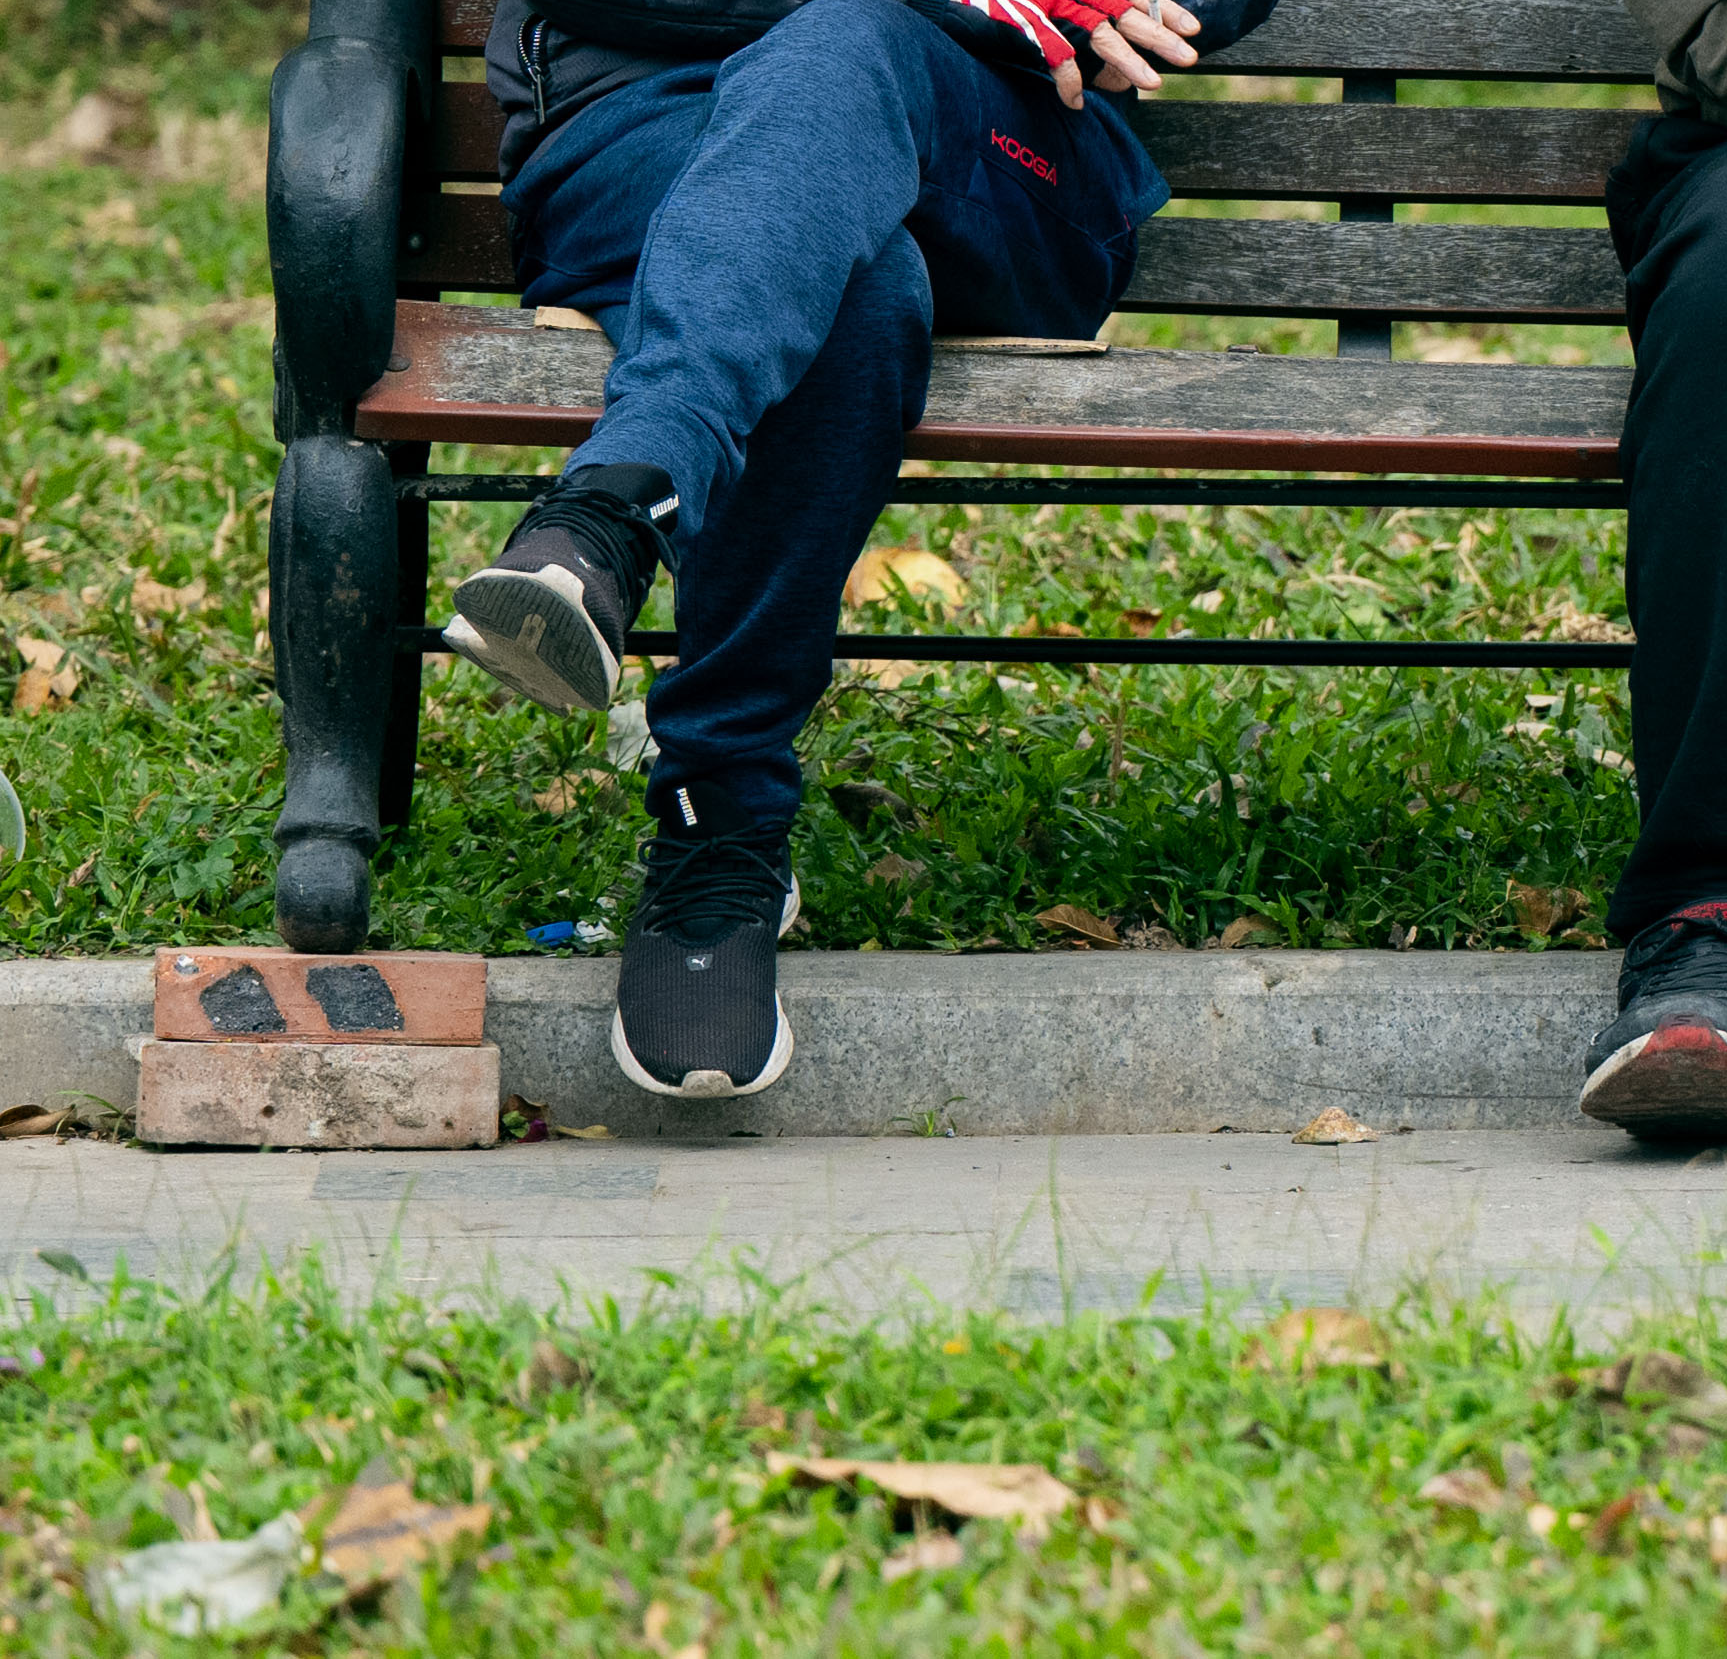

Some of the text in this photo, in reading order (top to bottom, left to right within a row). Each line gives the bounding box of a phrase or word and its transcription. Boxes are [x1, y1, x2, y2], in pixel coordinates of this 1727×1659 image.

[991, 128, 1057, 187] KOOGA
[649, 493, 680, 520] PUMA
[676, 787, 698, 826] PUMA
